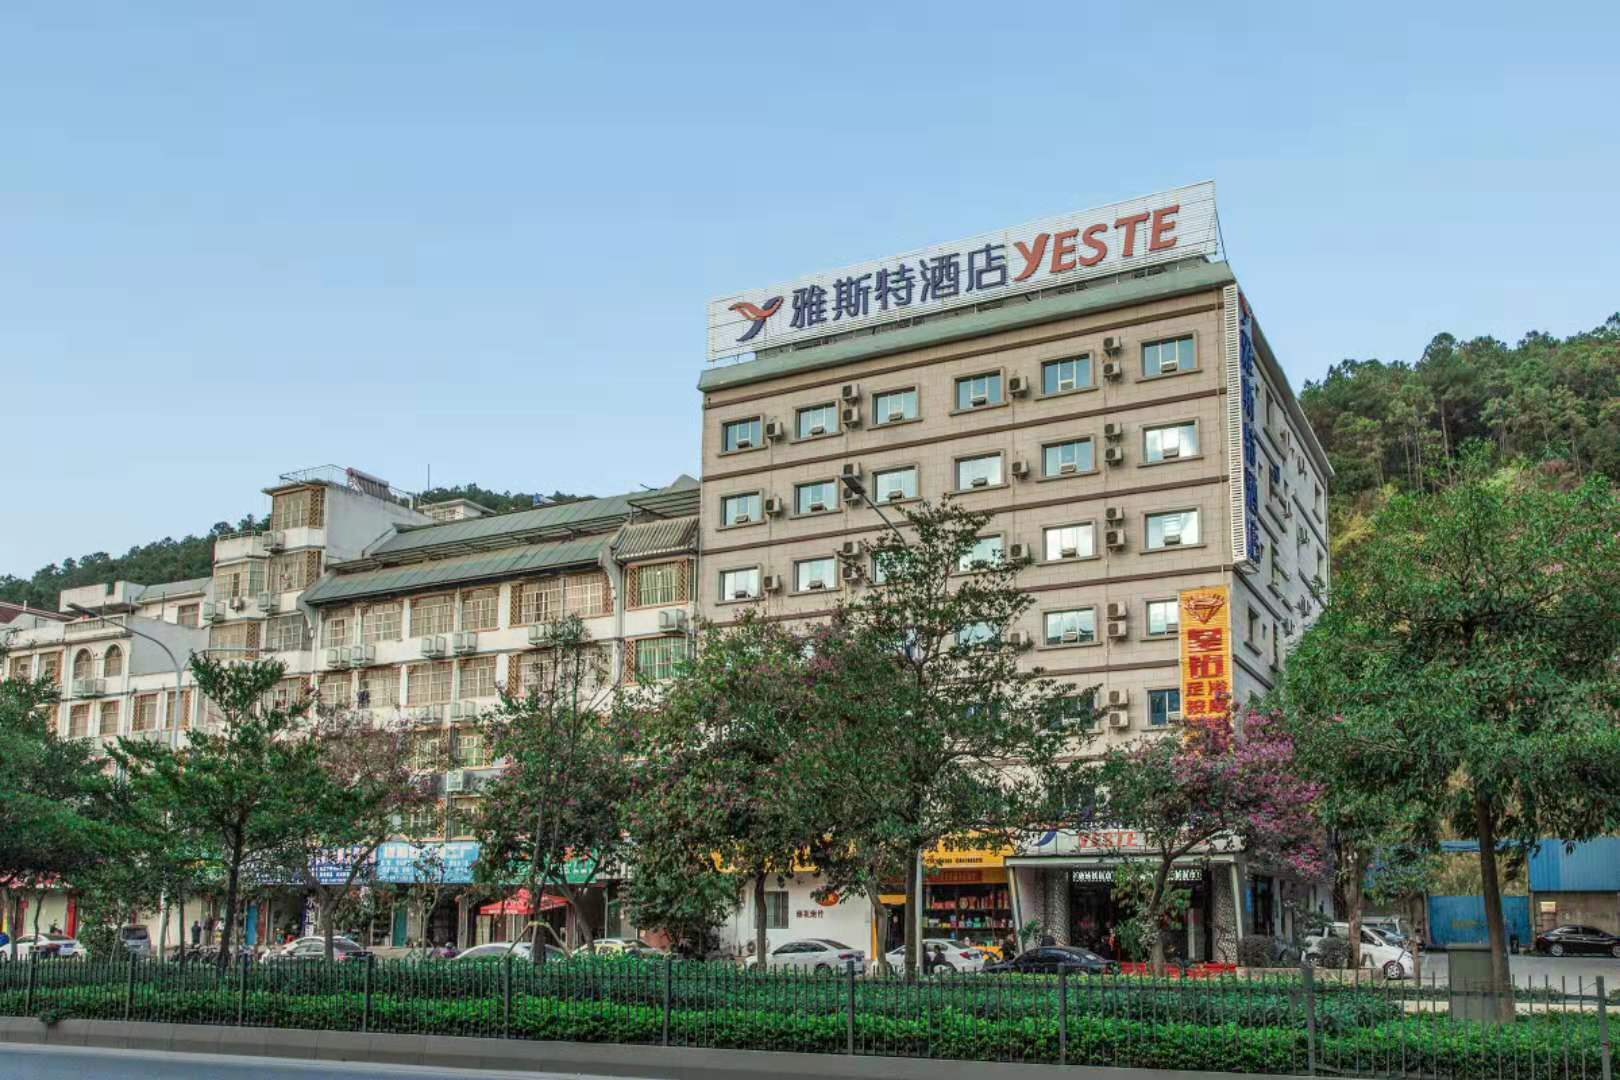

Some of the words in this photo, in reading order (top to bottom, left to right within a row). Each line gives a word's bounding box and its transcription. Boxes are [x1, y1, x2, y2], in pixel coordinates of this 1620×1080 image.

[1012, 204, 1180, 282] YESTE
[789, 243, 1008, 329] 雅斯特酒店
